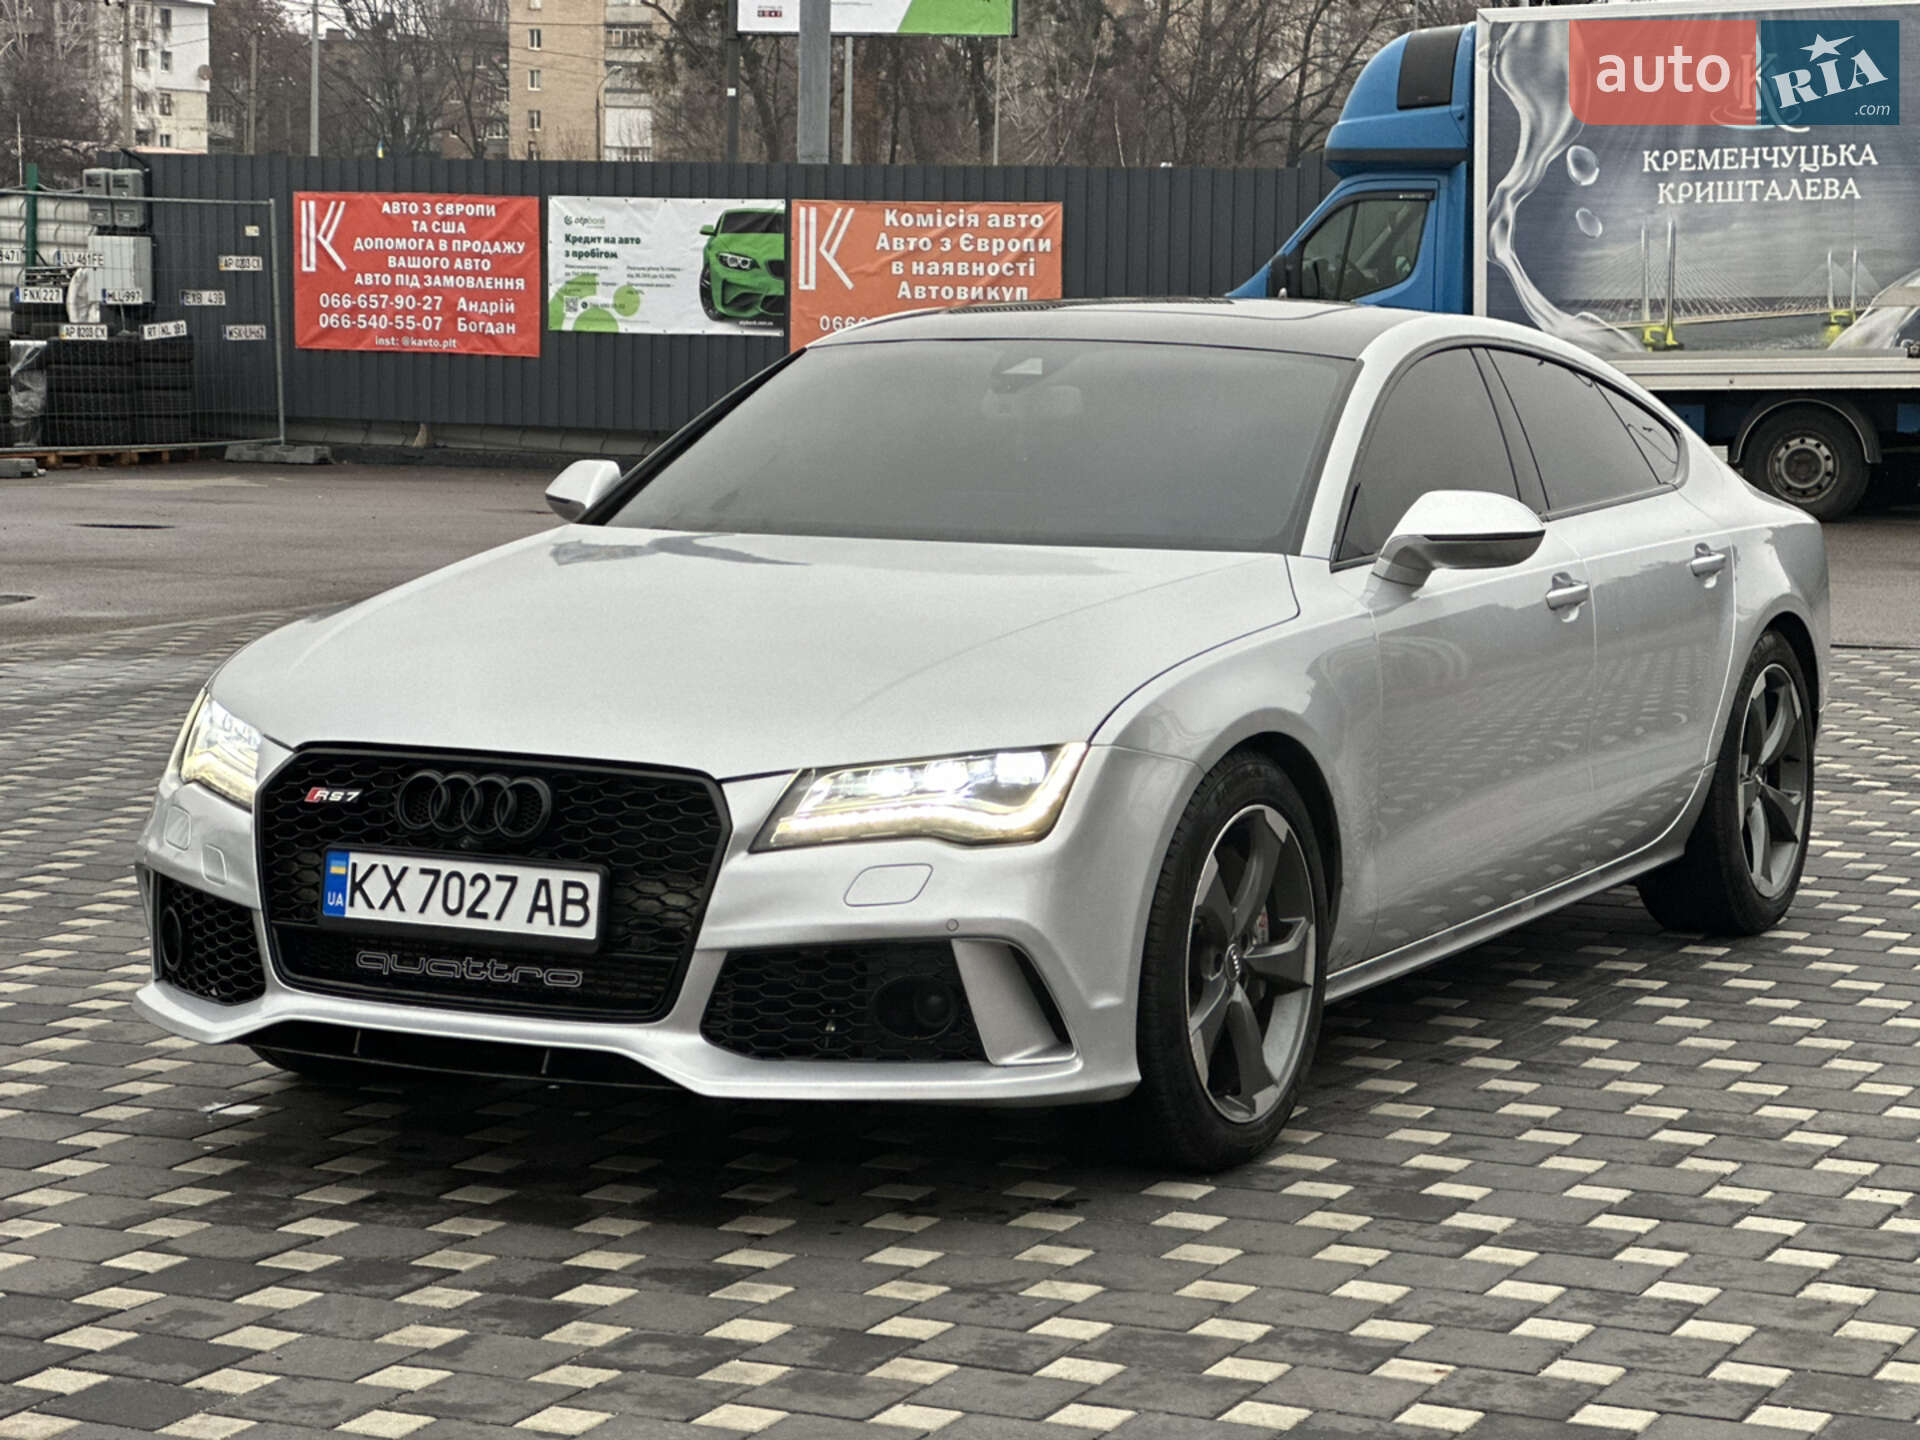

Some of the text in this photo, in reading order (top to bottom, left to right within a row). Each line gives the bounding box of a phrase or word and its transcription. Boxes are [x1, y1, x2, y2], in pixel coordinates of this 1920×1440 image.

[1642, 144, 1879, 173] КРЕМЕНЧУЦЬКА
[1658, 178, 1861, 204] КРИШТАЛЕВА
[382, 202, 496, 217] АВТО З ЄВРОПИ
[885, 208, 1044, 228] Комісія авто
[412, 220, 467, 234] ТА США
[353, 237, 525, 255] ДОПОМОГА В ПРОДАЖУ
[564, 233, 641, 245] Кредит на авто
[876, 232, 1052, 256] Авто з Європи
[388, 256, 491, 271] ВАШОГО АВТО
[571, 248, 618, 260] пробігом
[891, 257, 1036, 276] в наявності
[354, 273, 526, 290] АВТО ПІД ЗАМОВЛЕННЯ
[897, 281, 1029, 301] Автовикуп
[319, 292, 515, 316] 066-657-90-27 Андрій
[319, 312, 516, 335] 066-540-55-07 Богдан
[311, 788, 361, 802] RS7
[327, 891, 344, 907] UA
[348, 862, 590, 928] KX 7027 AB
[355, 951, 583, 987] quattro
